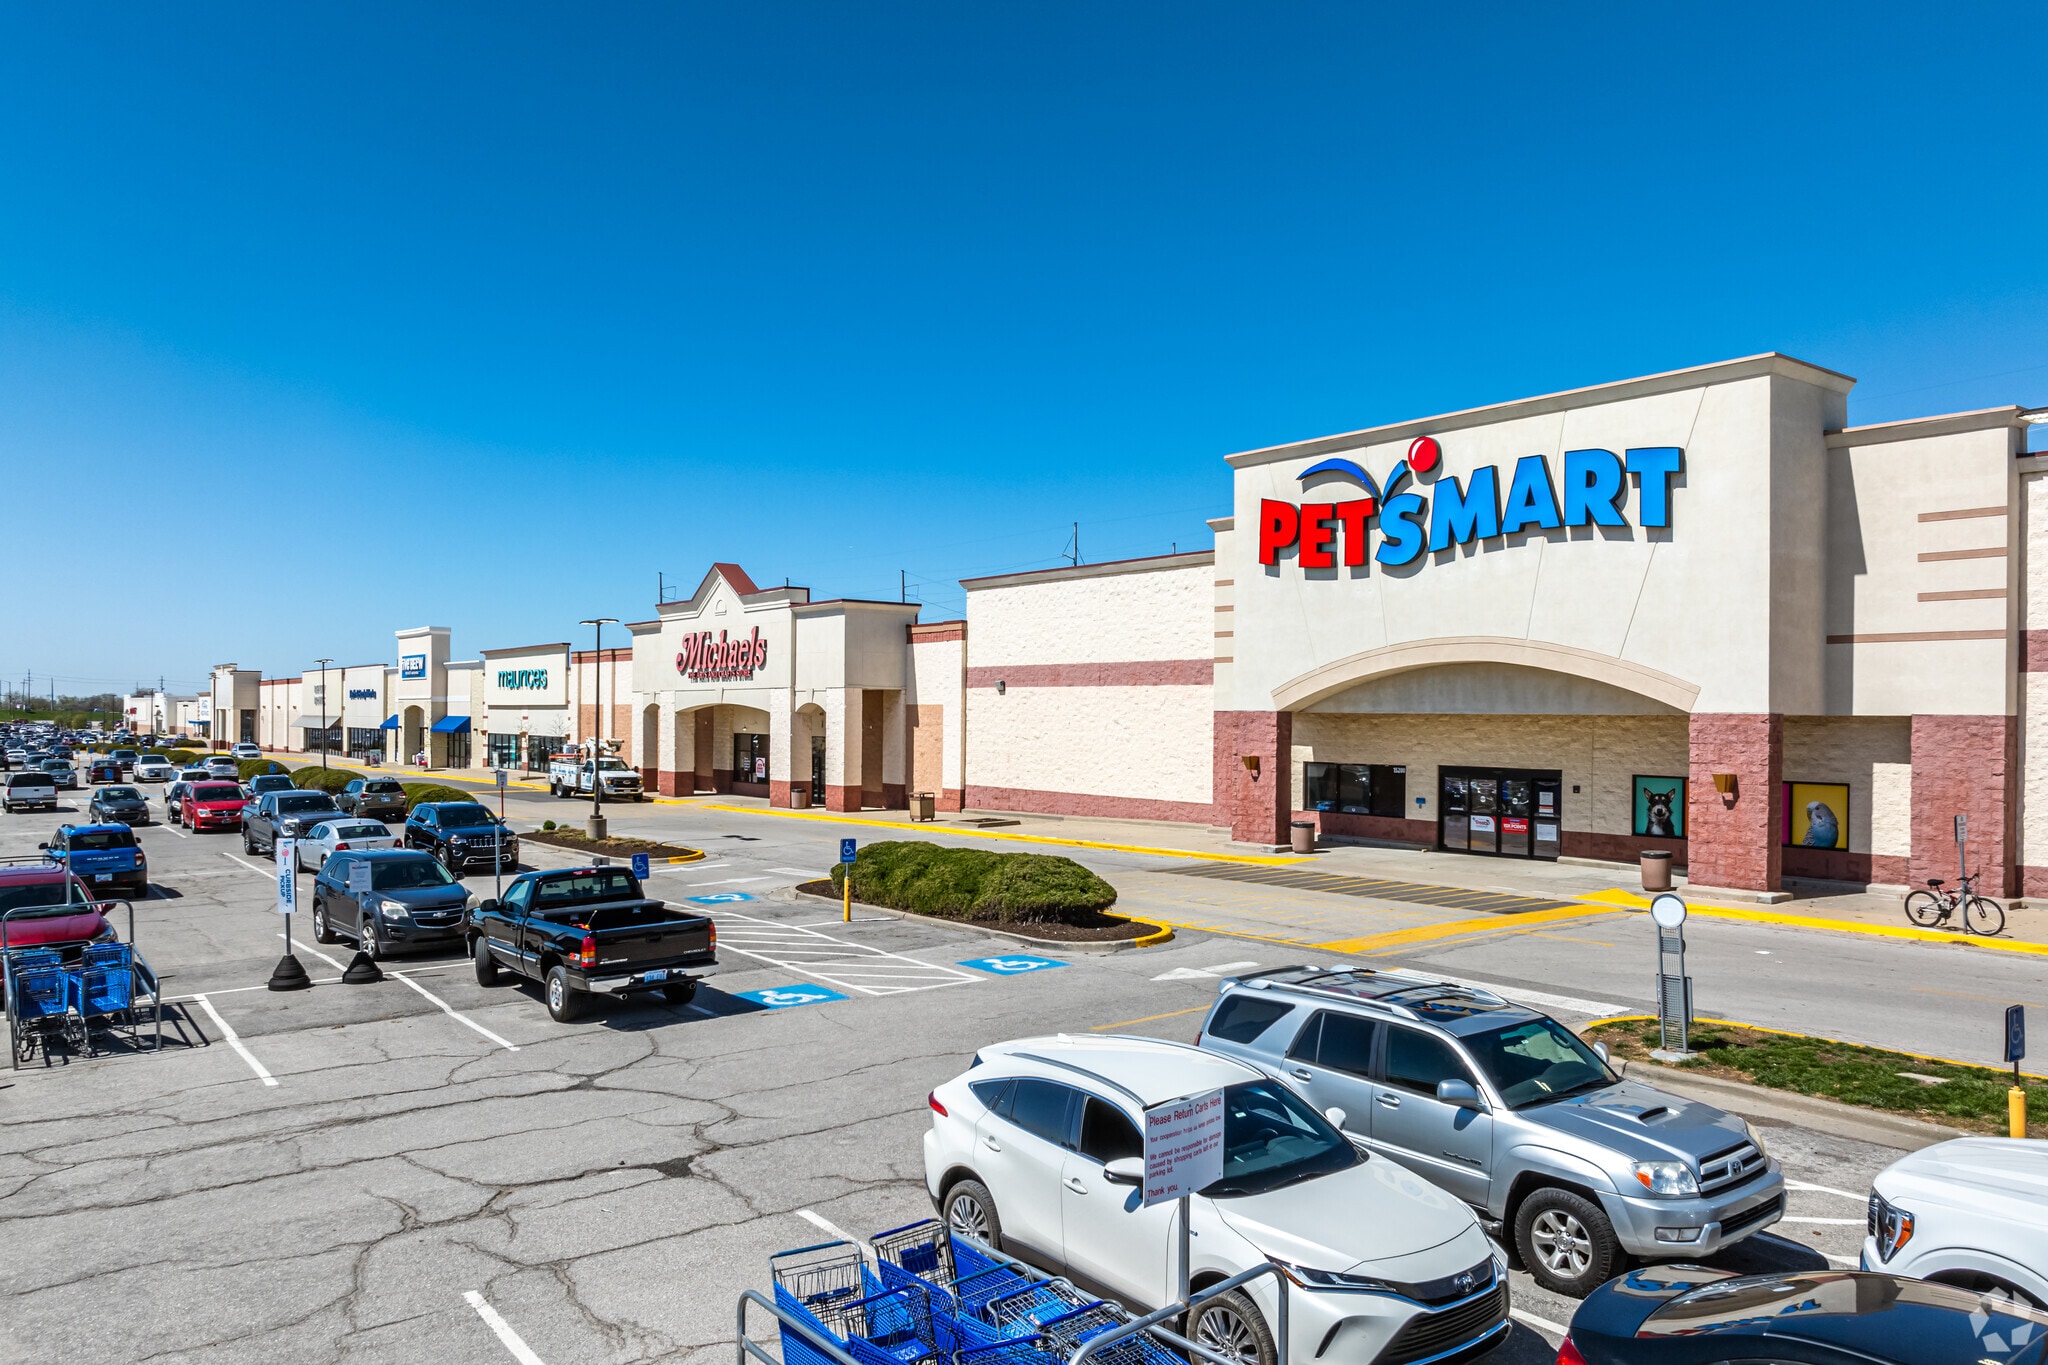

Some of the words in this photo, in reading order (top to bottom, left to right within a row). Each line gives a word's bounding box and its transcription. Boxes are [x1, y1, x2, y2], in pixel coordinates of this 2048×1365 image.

[1259, 446, 1685, 569] PETSMART
[676, 626, 766, 672] Michaels
[498, 669, 548, 688] maurices
[1150, 1114, 1171, 1127] Please
[1174, 1108, 1193, 1121] Return
[1195, 1102, 1209, 1114] Carts
[1210, 1097, 1221, 1108] Here
[1158, 1148, 1173, 1158] cannot
[1181, 1139, 1202, 1151] responsible
[1209, 1132, 1221, 1141] damage
[1160, 1130, 1182, 1140] cooperation
[1149, 1159, 1165, 1170] caused
[1167, 1158, 1172, 1166] by
[1174, 1152, 1192, 1163] shopping
[1193, 1148, 1202, 1156] carts
[1149, 1169, 1165, 1179] parking
[1148, 1186, 1164, 1197] Thank
